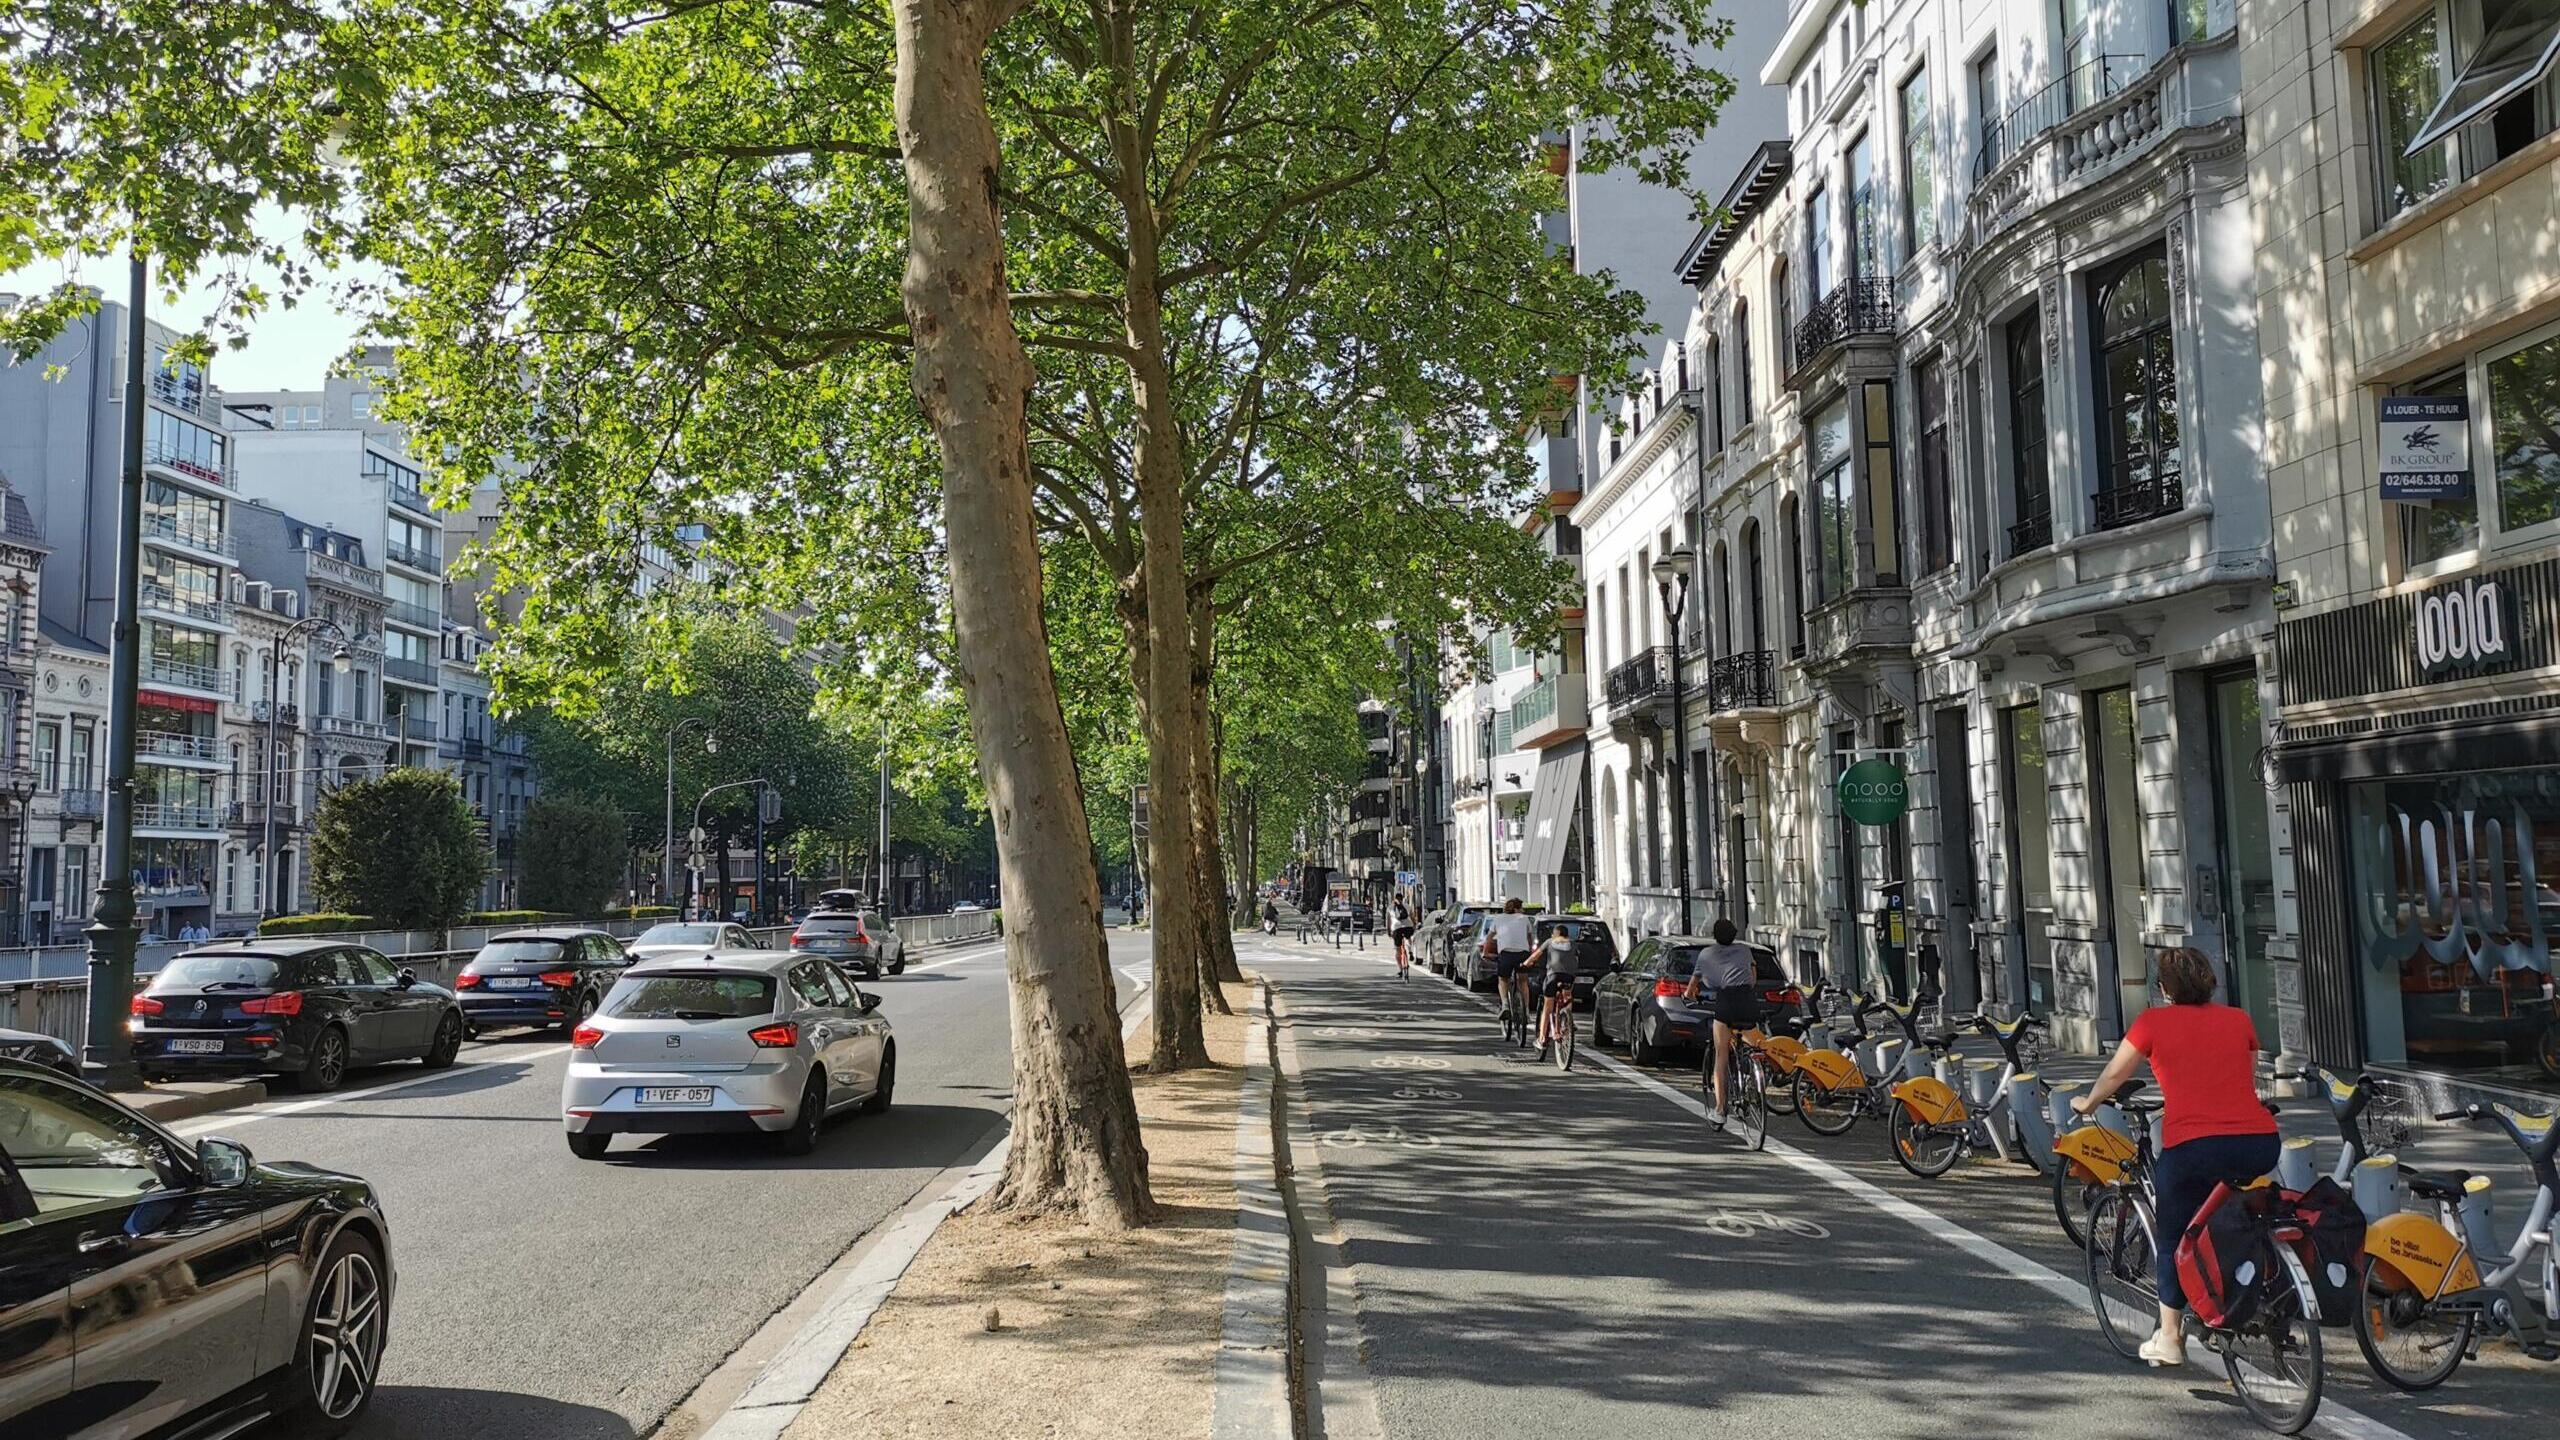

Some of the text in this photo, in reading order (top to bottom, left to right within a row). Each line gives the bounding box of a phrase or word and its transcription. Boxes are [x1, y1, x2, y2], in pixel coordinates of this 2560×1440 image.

[2386, 406, 2392, 415] A
[2393, 405, 2419, 415] LOUER
[2424, 405, 2435, 414] TE
[2436, 405, 2459, 414] HUUR
[2391, 454, 2453, 465] BK GROUP
[2386, 474, 2459, 486] 02/646.38.00
[2415, 577, 2504, 671] loola
[1845, 781, 1903, 796] nood
[1892, 895, 1901, 907] P
